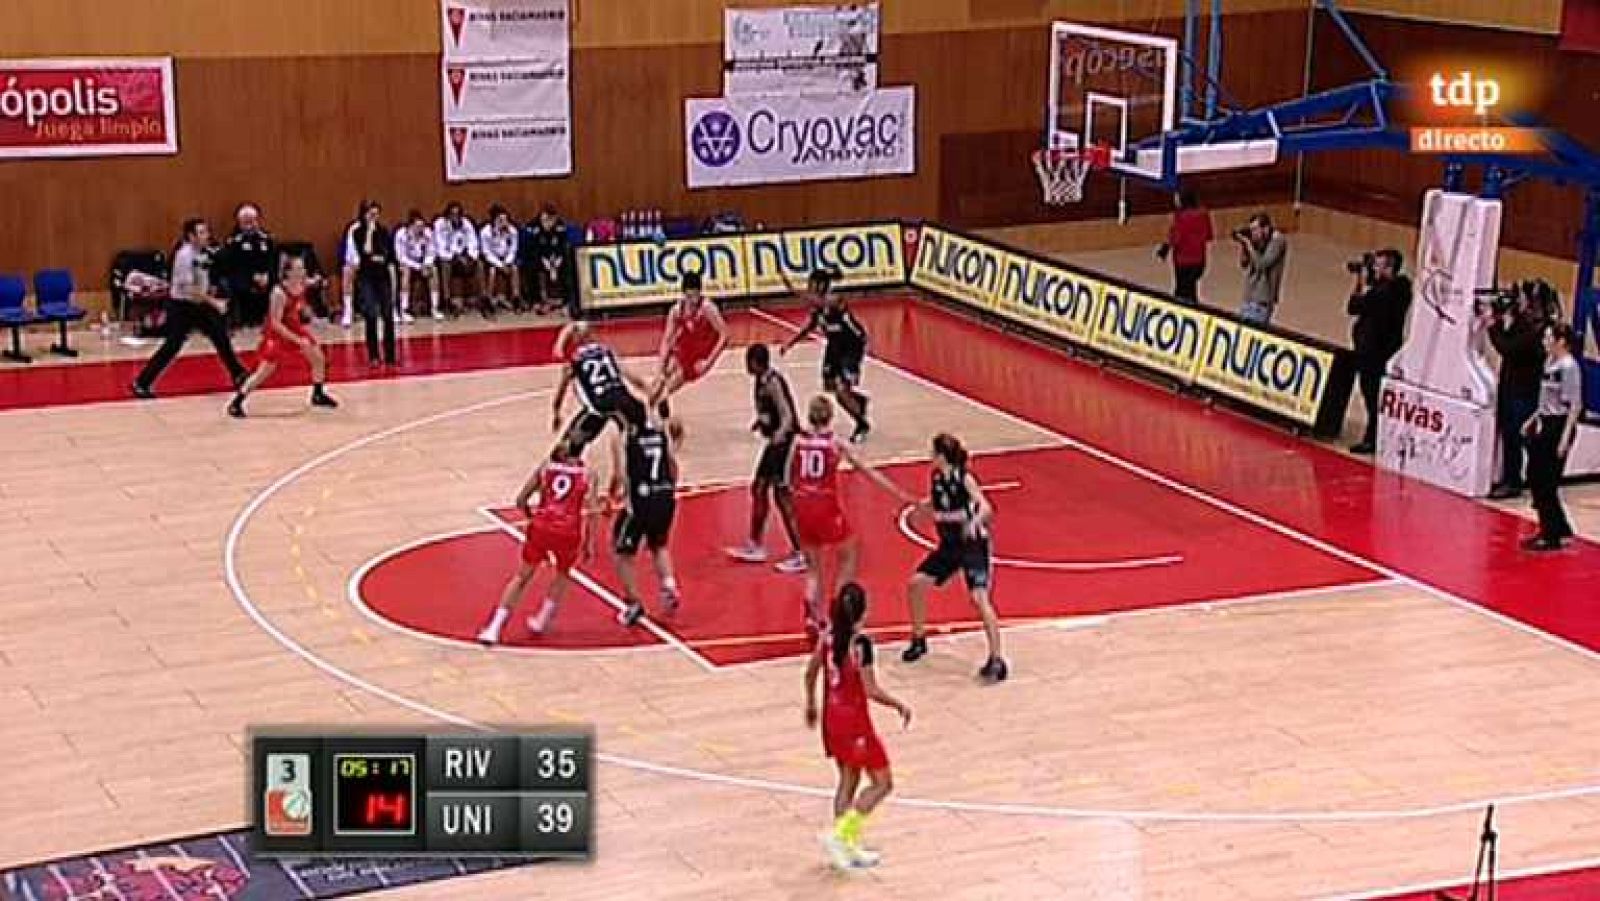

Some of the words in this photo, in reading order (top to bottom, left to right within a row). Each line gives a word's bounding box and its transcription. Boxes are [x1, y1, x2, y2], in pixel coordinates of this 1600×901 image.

[0, 76, 120, 126] ópolis
[747, 109, 898, 164] Cryovac
[581, 355, 619, 384] 21
[1380, 388, 1444, 434] Rivas
[644, 446, 663, 481] 7
[800, 448, 825, 478] 10
[552, 473, 572, 500] 9
